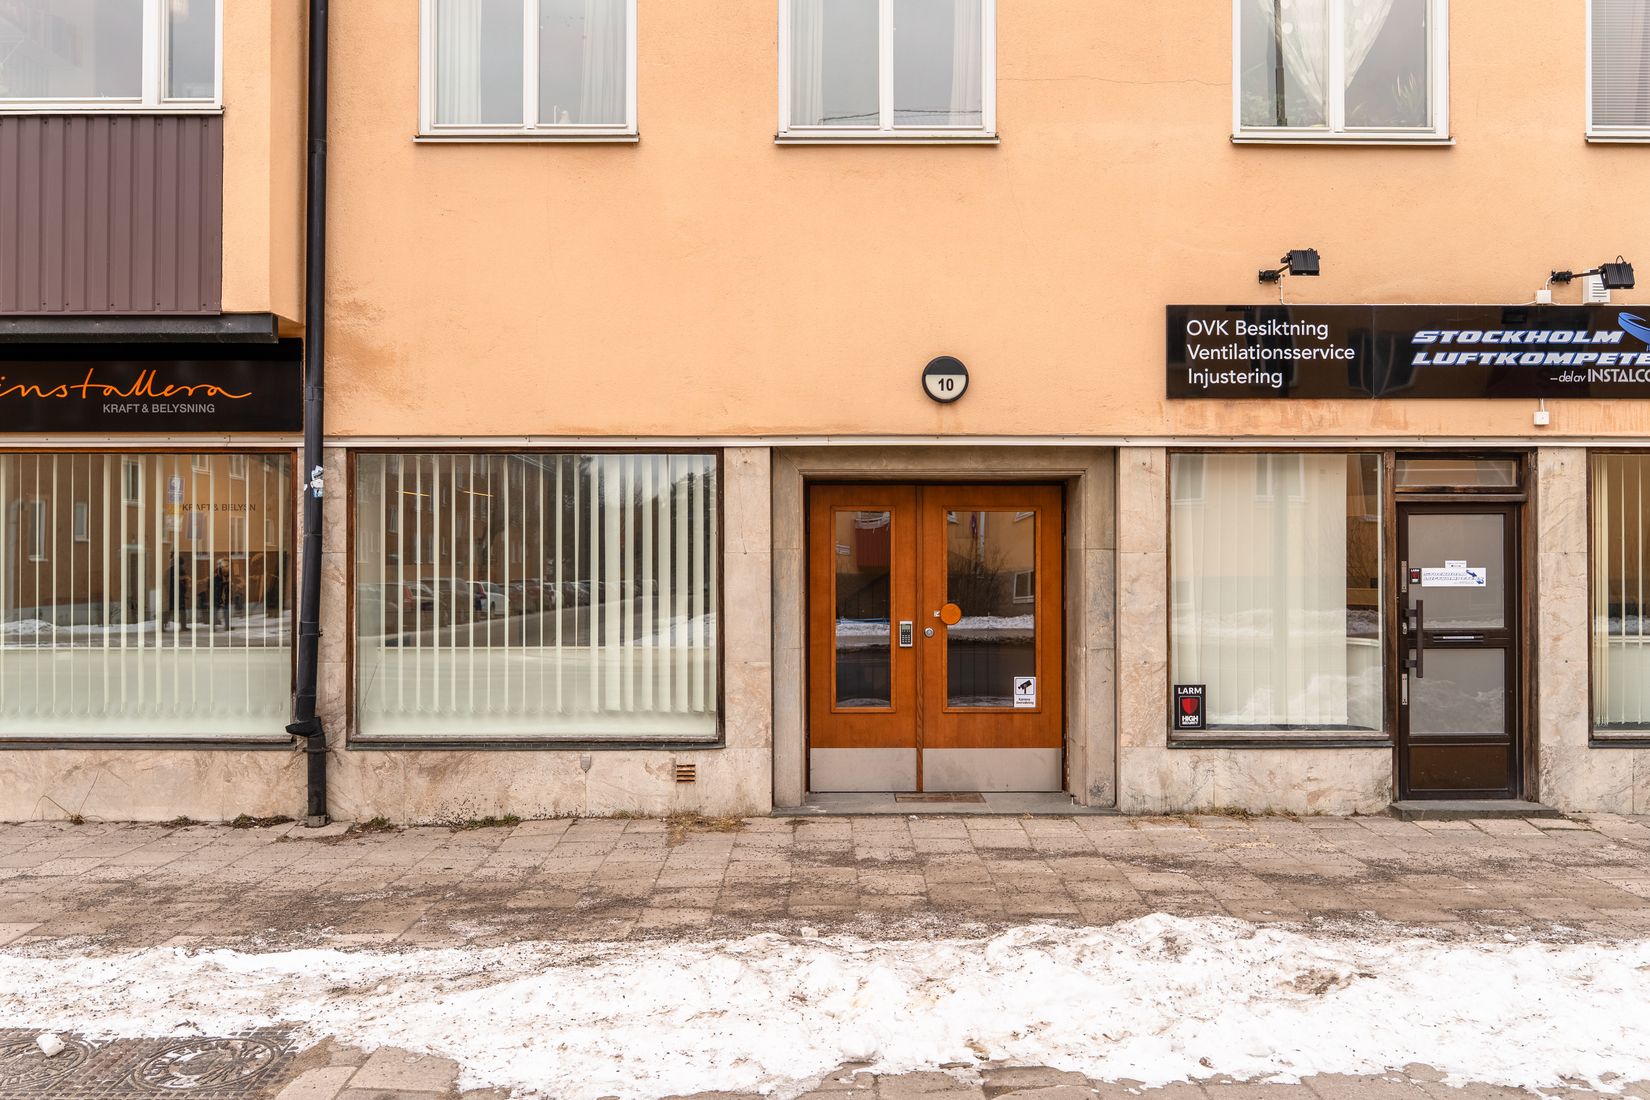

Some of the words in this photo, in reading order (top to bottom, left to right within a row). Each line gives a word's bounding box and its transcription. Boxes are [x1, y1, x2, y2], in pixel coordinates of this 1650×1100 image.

[1186, 319, 1229, 336] OVK
[1235, 319, 1329, 340] Besiktning
[1411, 330, 1625, 344] STOCKHOLM
[1187, 343, 1356, 360] Ventilationsservice
[1411, 352, 1650, 366] LUFTKOMPETE
[938, 378, 954, 391] 10
[1188, 368, 1283, 388] Injustering
[103, 403, 140, 413] KRAFT
[141, 403, 150, 413] &
[152, 403, 215, 413] BELYSNING
